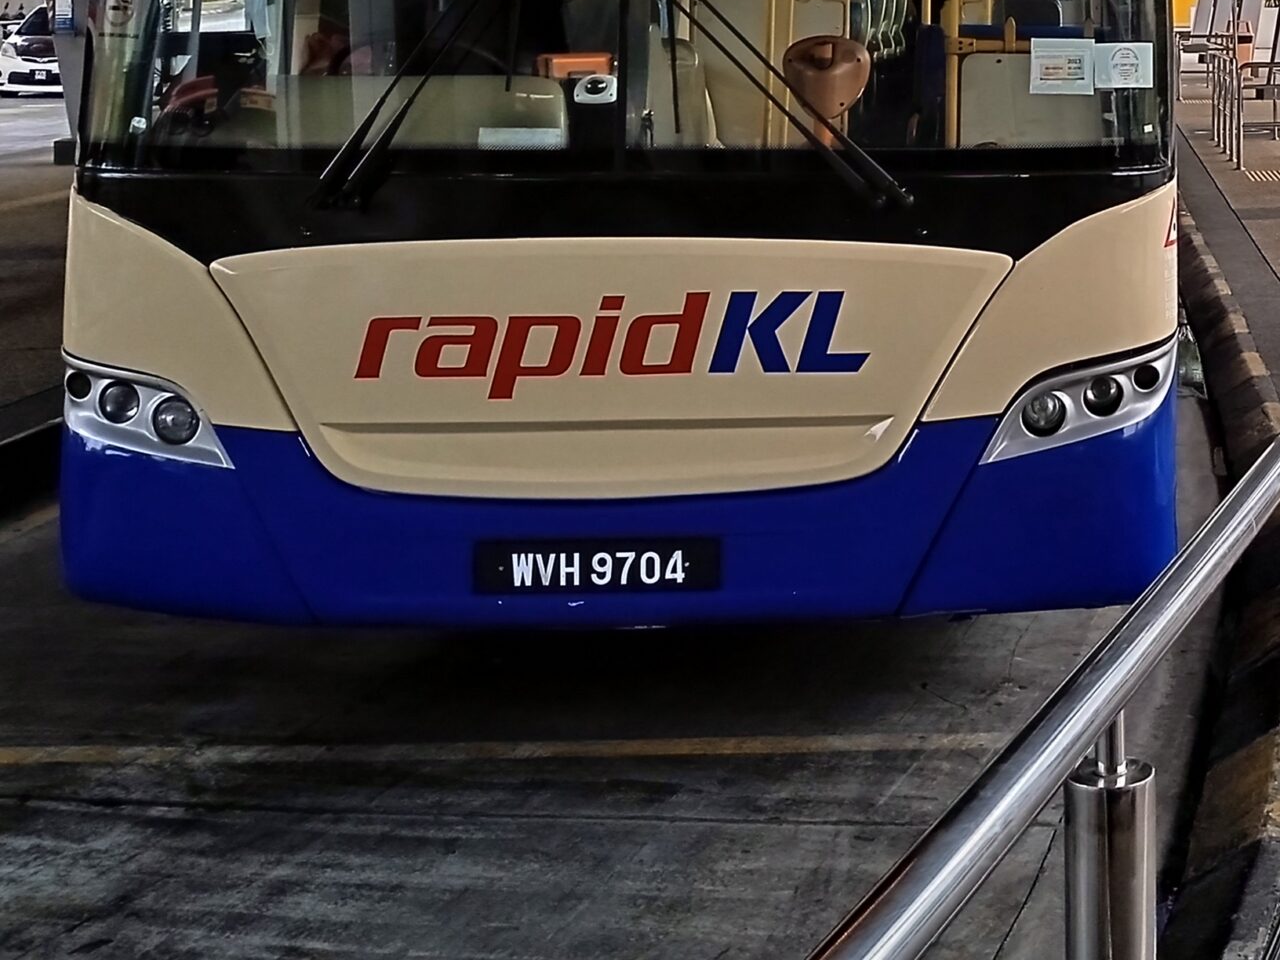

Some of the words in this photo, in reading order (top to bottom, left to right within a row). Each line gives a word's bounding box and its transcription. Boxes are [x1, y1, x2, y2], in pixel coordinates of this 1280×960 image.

[353, 290, 872, 401] rapidKL
[511, 552, 581, 587] WVH
[590, 549, 686, 586] 9704
